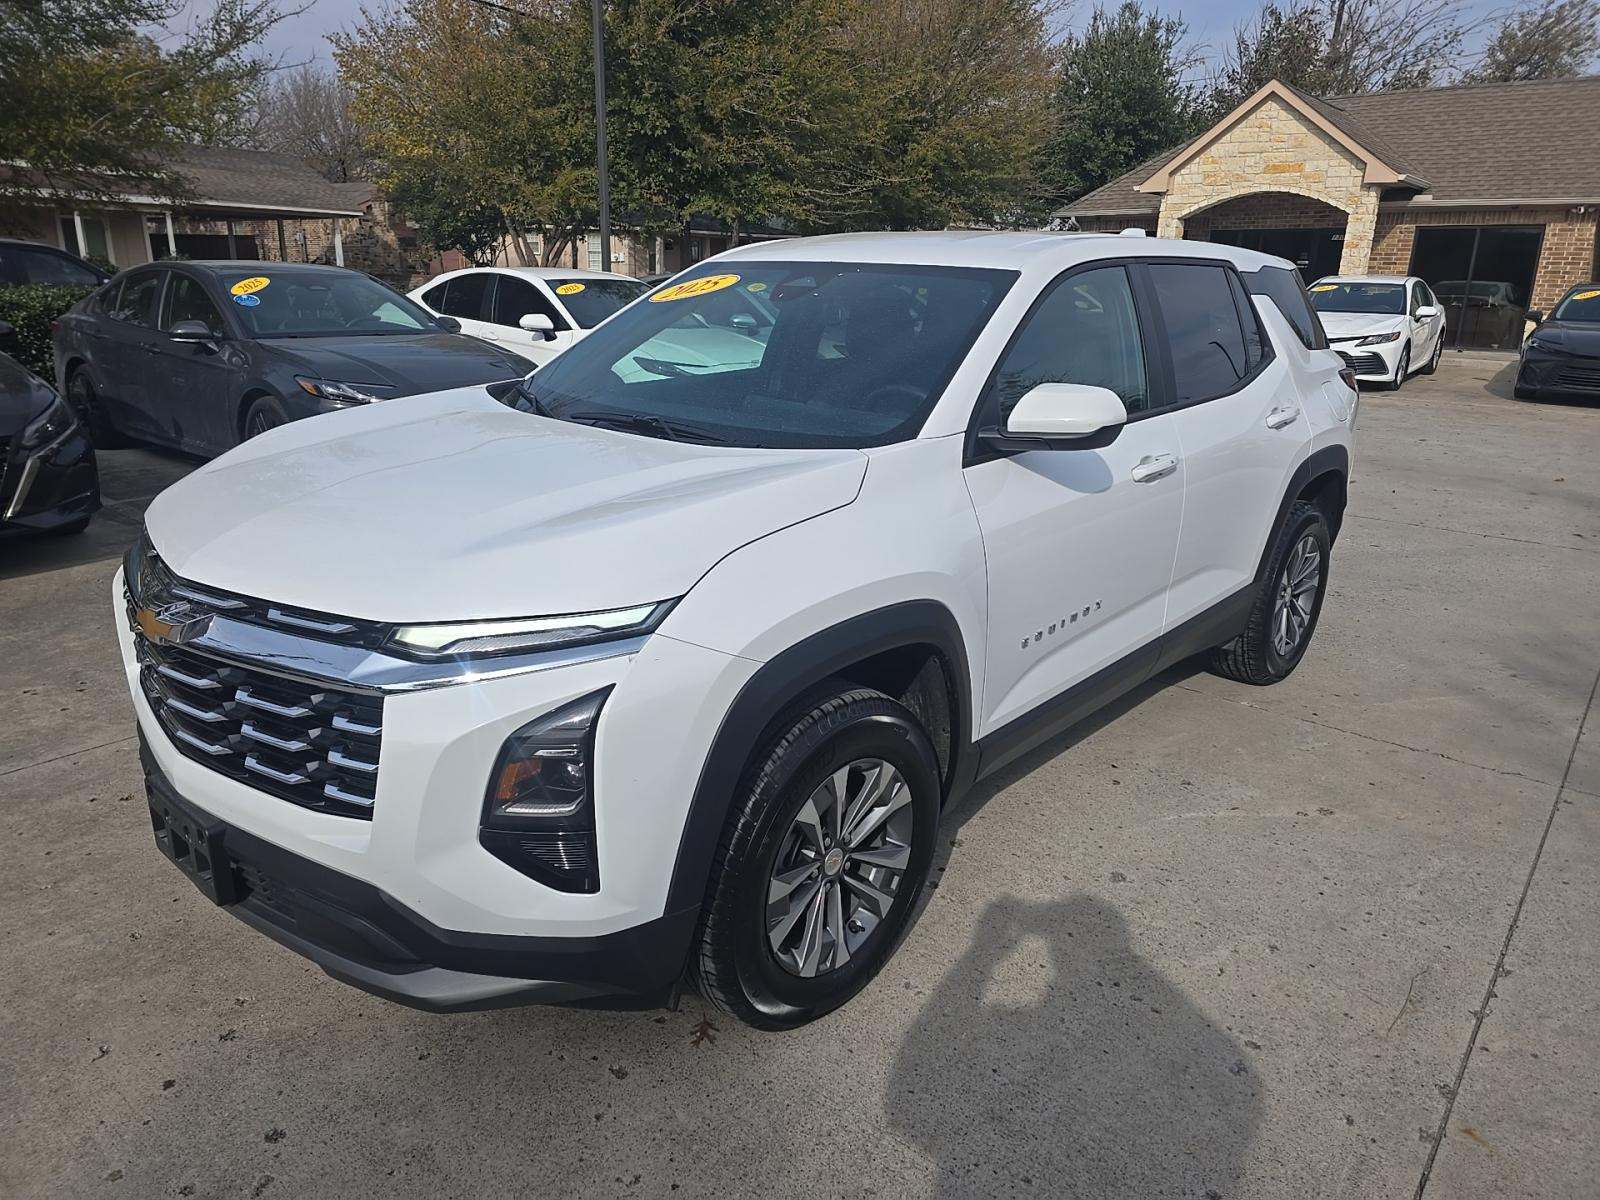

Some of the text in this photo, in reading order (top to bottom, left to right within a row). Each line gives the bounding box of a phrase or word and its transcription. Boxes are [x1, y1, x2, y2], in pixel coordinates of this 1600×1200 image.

[237, 278, 263, 293] 2025
[659, 277, 728, 299] 2025
[1021, 600, 1102, 649] EQUINOX
